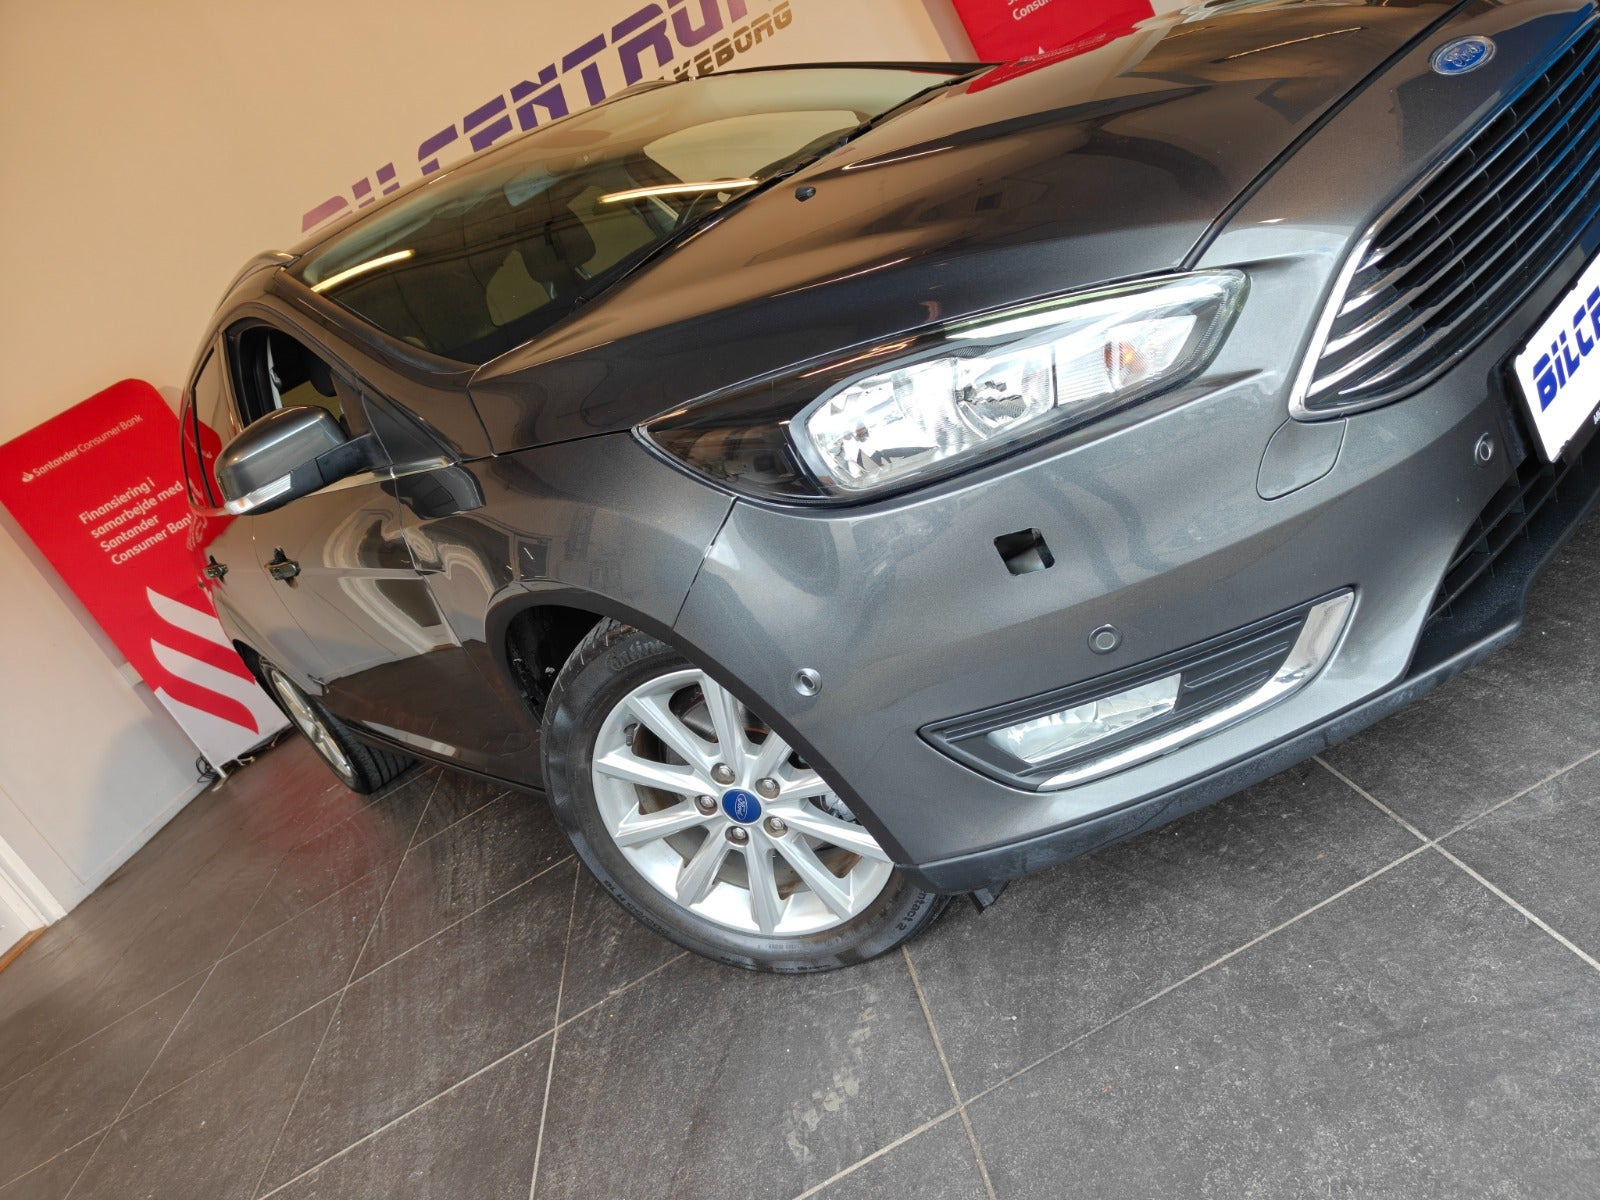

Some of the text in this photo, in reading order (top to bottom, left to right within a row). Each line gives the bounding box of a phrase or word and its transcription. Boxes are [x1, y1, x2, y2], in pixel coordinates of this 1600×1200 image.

[1012, 0, 1051, 20] Consu
[672, 1, 793, 81] KEBORG
[33, 414, 143, 477] Santander Consumer Bank
[79, 482, 151, 525] Finansiering
[91, 497, 157, 538] samarbejde
[157, 480, 184, 504] med
[101, 514, 159, 552] Santander
[111, 532, 168, 565] Consumer
[904, 892, 927, 922] ntact
